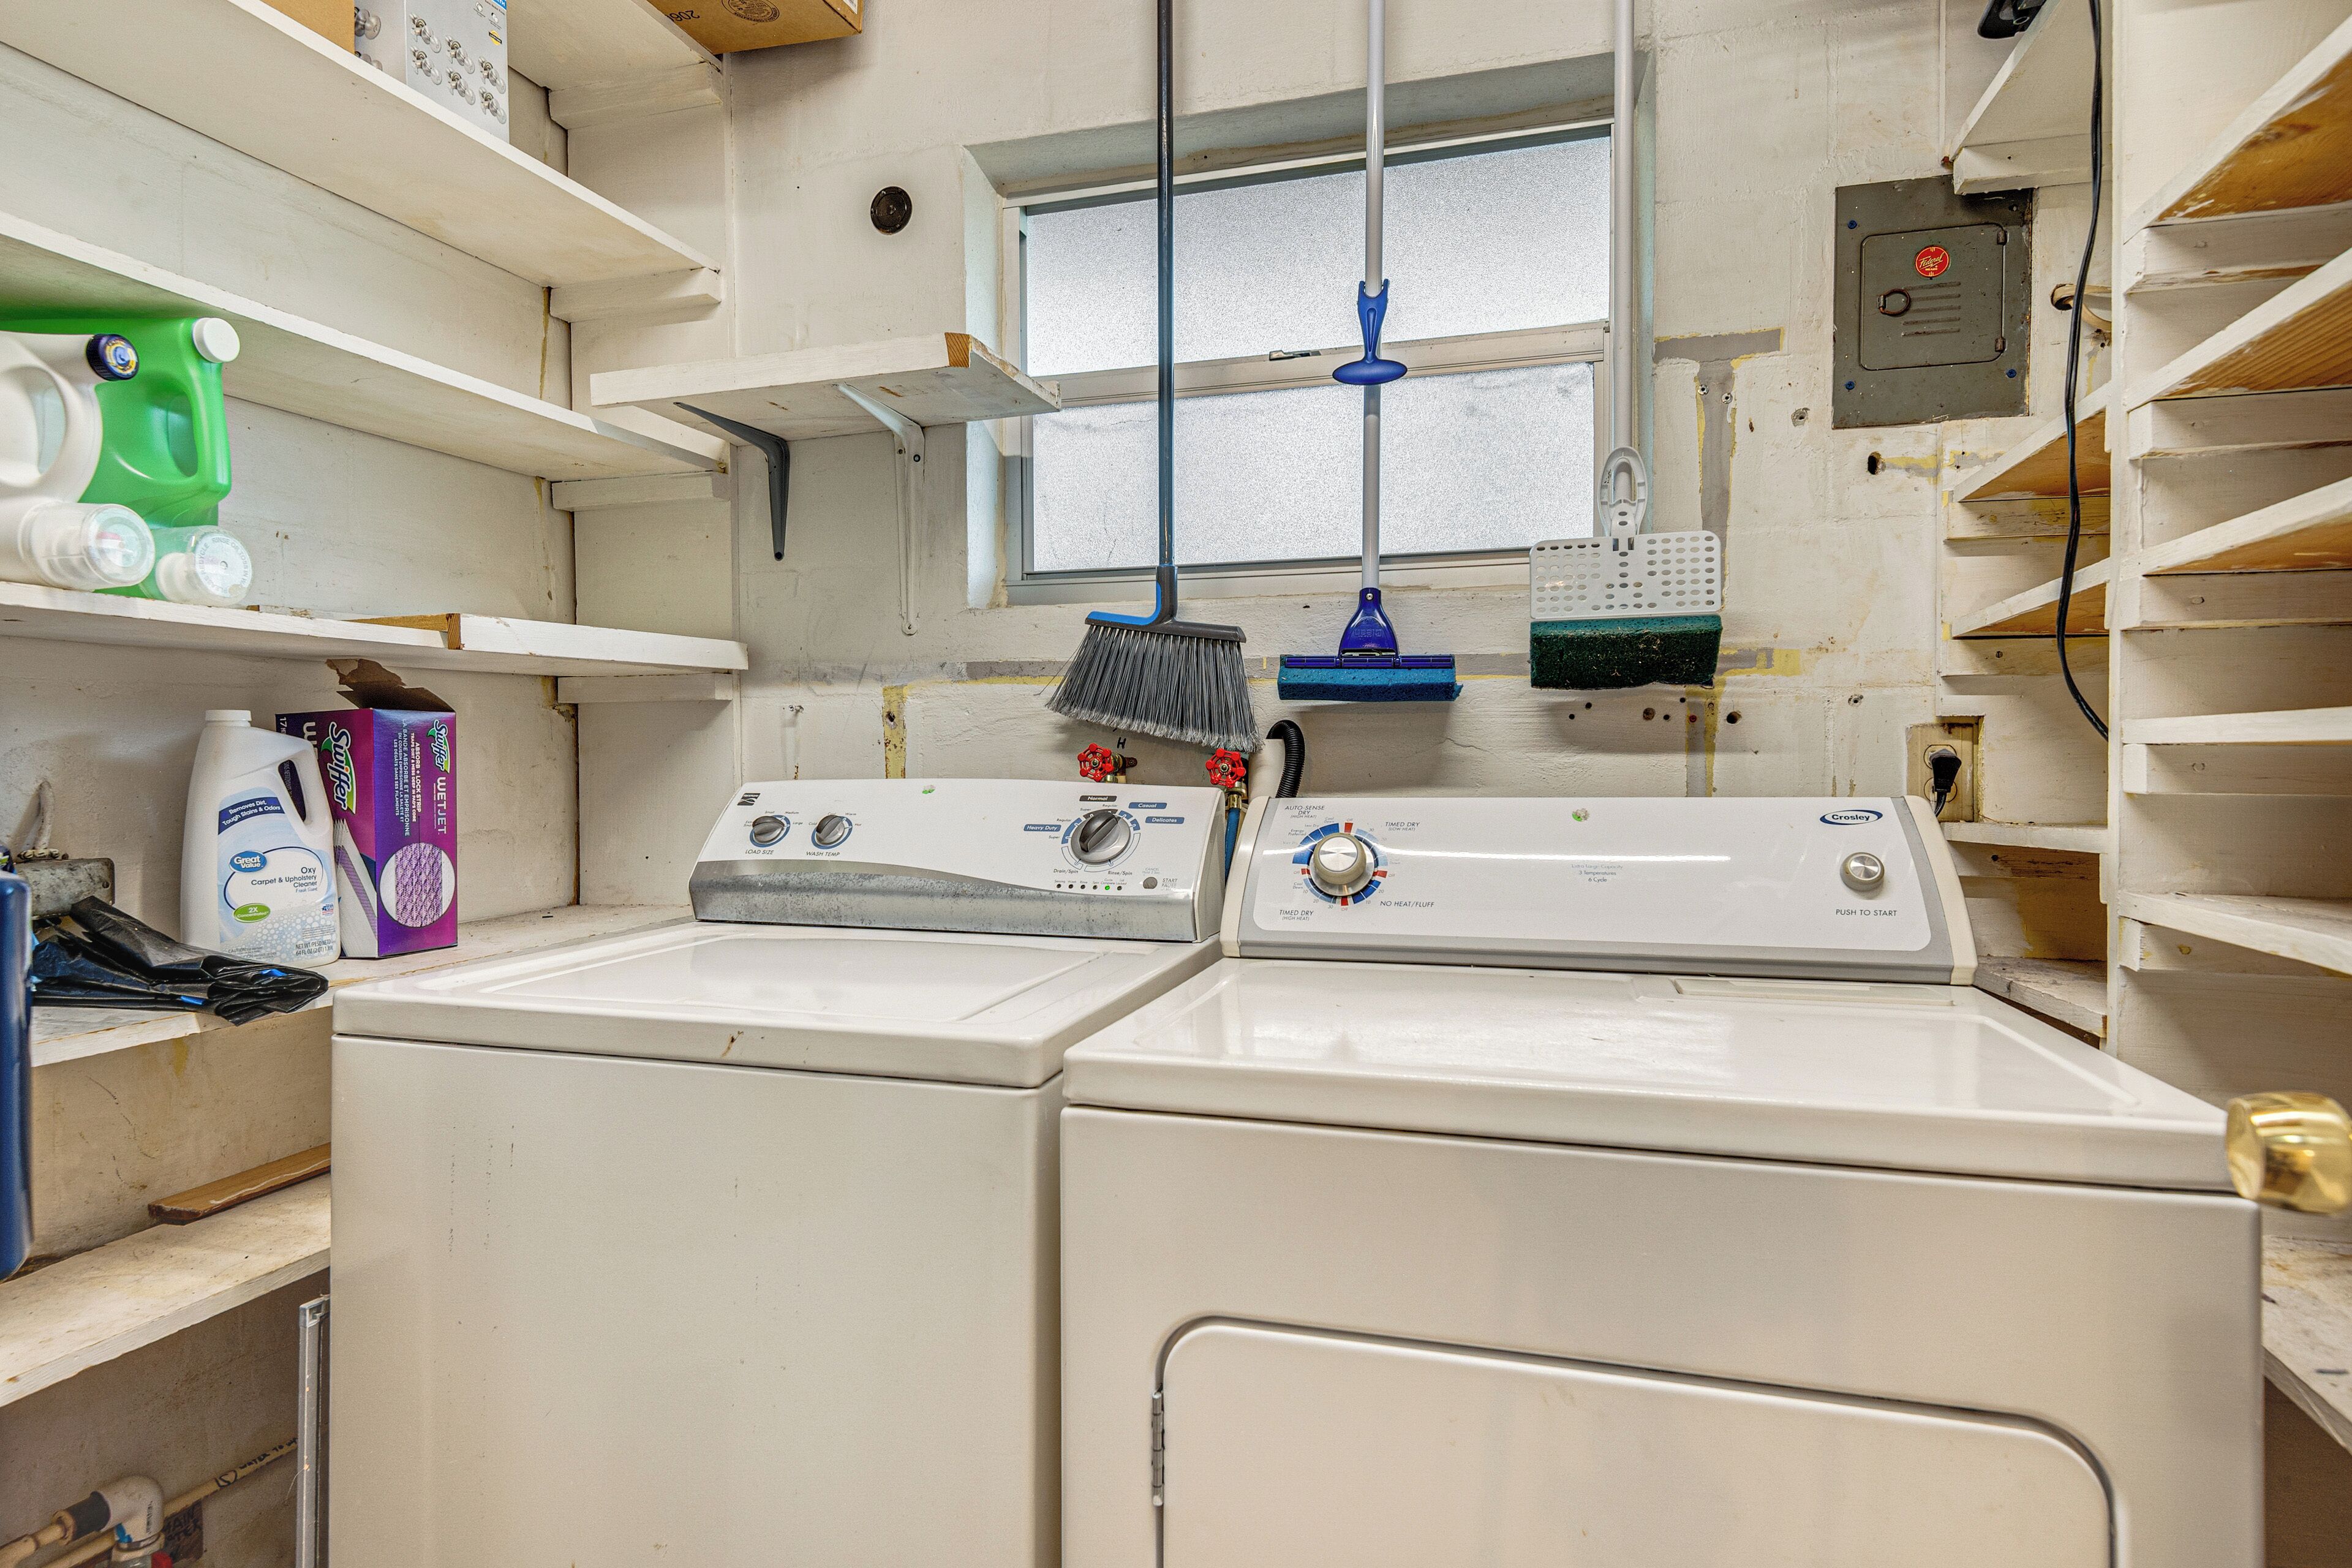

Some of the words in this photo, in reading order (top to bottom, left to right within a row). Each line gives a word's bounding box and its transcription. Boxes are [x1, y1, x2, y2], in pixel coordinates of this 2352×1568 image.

[1918, 252, 1945, 268] Federal
[279, 717, 287, 727] 17
[431, 720, 448, 771] Swiffer
[1117, 737, 1126, 749] H
[327, 722, 351, 810] Swiffer
[228, 802, 256, 815] Removes
[437, 777, 447, 834] WETJET
[222, 815, 241, 826] Tough
[241, 808, 258, 817] Stains
[233, 856, 261, 864] Great
[251, 878, 276, 886] Carpet
[285, 874, 317, 883] Upholstery
